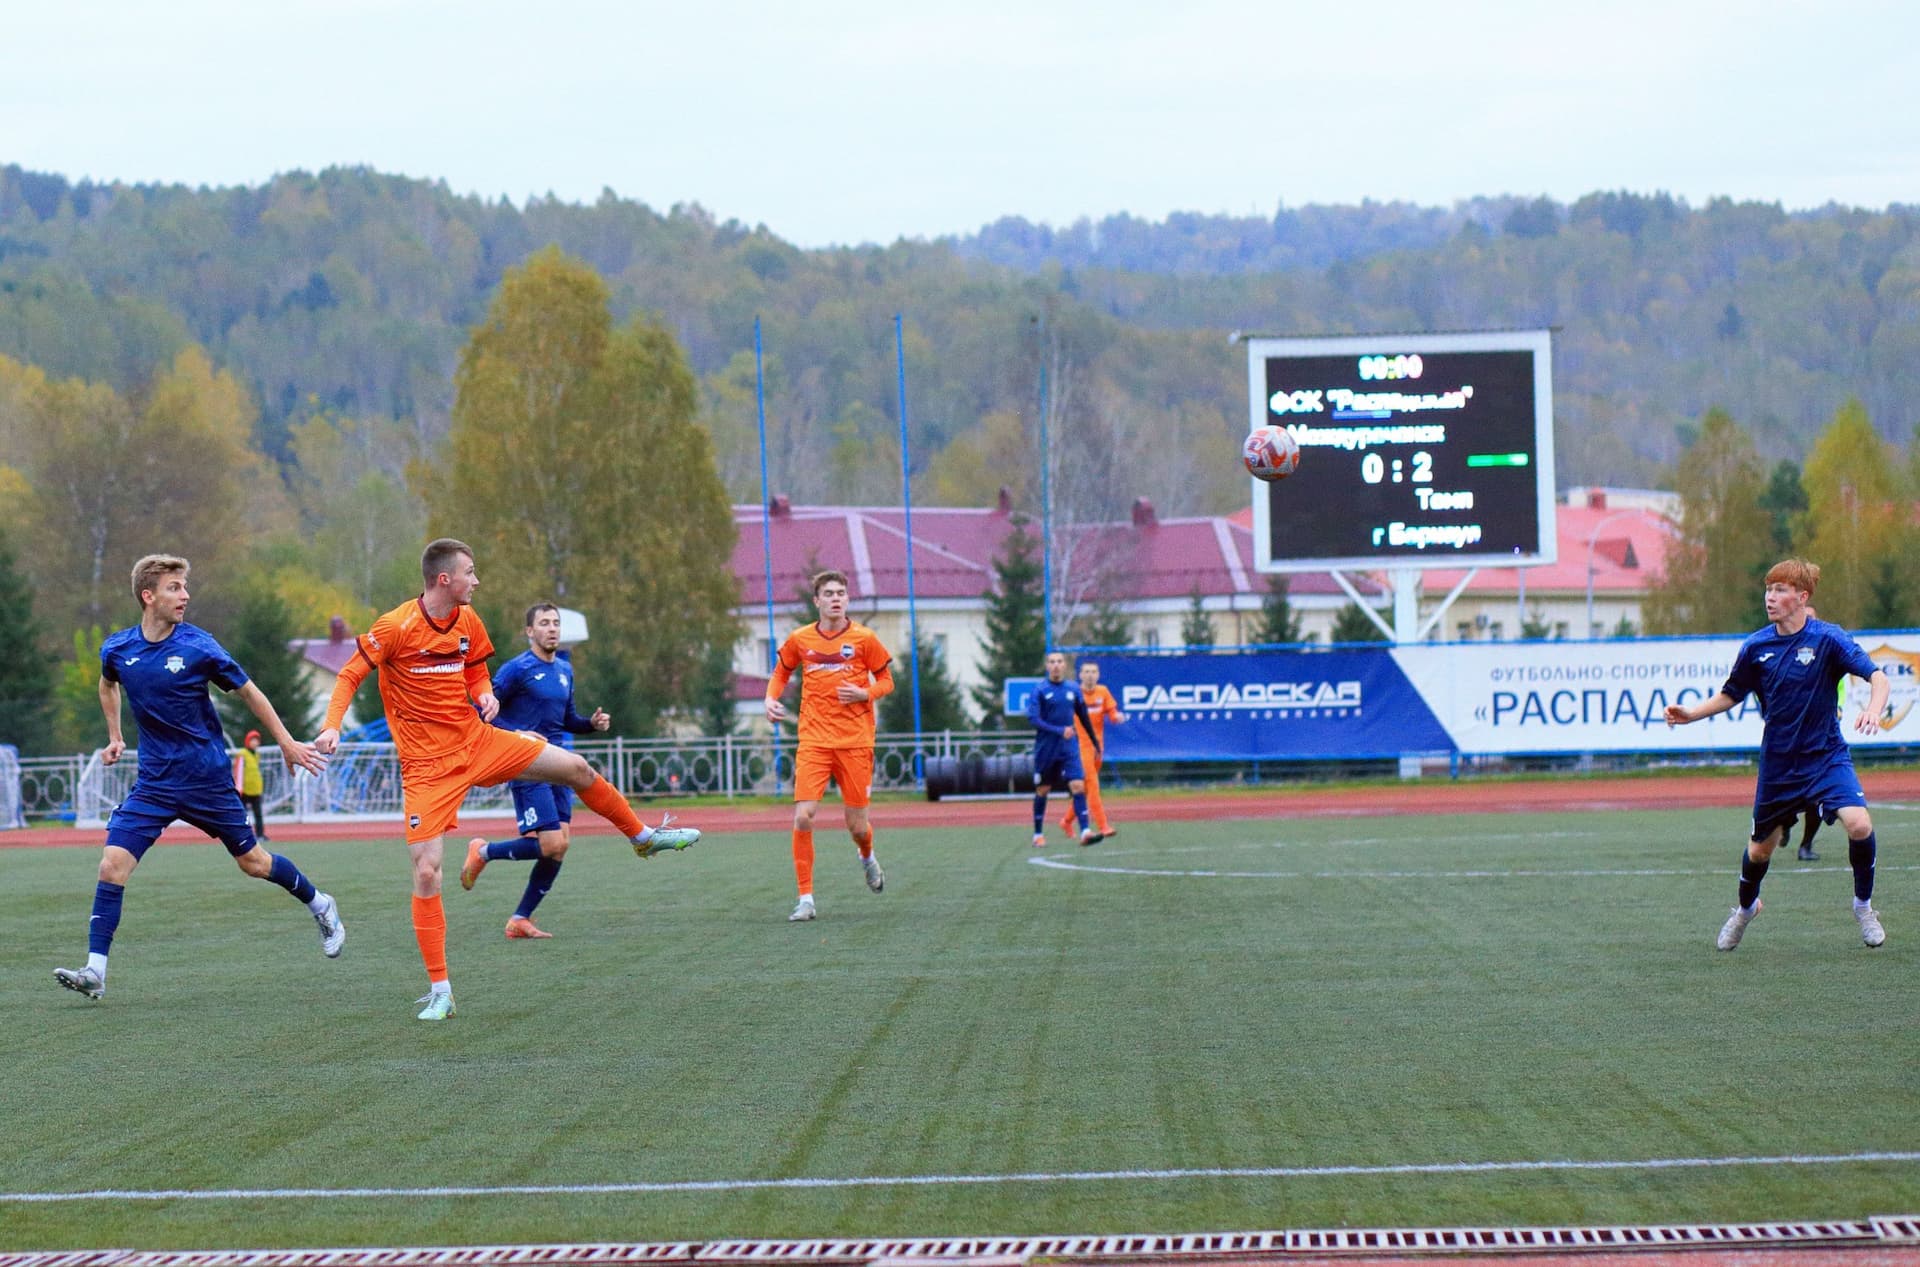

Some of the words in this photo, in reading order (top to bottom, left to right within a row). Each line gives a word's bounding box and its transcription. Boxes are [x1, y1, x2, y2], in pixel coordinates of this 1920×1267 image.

[1270, 389, 1324, 414] ФСК
[1361, 453, 1384, 484] 0
[1411, 451, 1433, 483] 2
[1122, 681, 1361, 710] РАСПАДСКАЯ
